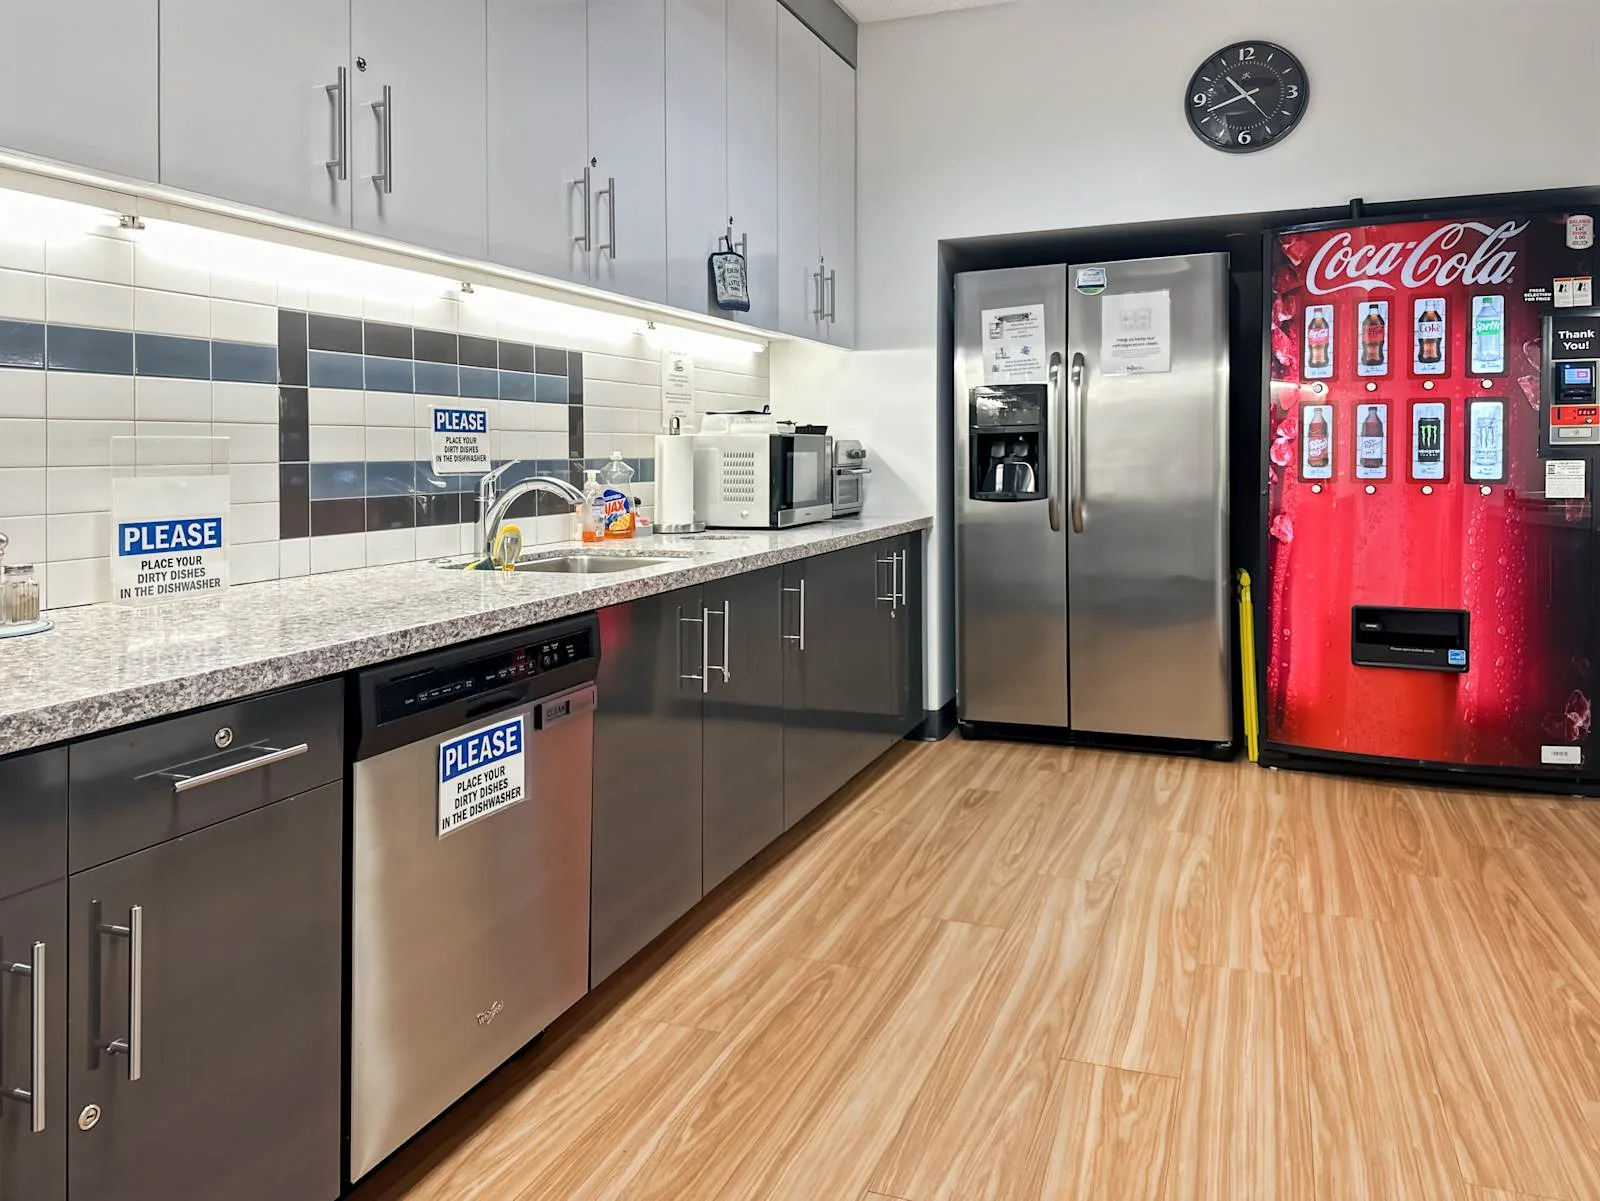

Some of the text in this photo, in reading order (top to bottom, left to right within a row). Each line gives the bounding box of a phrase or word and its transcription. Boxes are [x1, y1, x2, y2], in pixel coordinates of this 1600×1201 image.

[1239, 47, 1255, 60] 12
[1193, 93, 1207, 107] 9
[1285, 85, 1298, 99] 3
[1237, 130, 1252, 144] 6
[1305, 219, 1531, 296] Coca-Cola
[1558, 329, 1595, 340] Thank
[1562, 341, 1590, 351] You!
[436, 411, 485, 431] PLEASE
[446, 436, 462, 444] PLACE
[444, 445, 479, 453] DIRTY DISHES
[453, 454, 487, 462] DISHWASHER
[604, 500, 625, 516] JAX
[124, 521, 217, 552] PLEASE
[141, 555, 202, 571] PLACE YOUR
[137, 567, 206, 584] DIRTY DISHES
[120, 577, 221, 599] IN THE DISHWASHER
[445, 725, 518, 776] PLEASE
[457, 765, 506, 794] PLACE YOUR
[455, 778, 508, 809] DIRTY DISHES
[442, 786, 521, 830] IN THE DISHWASHER
